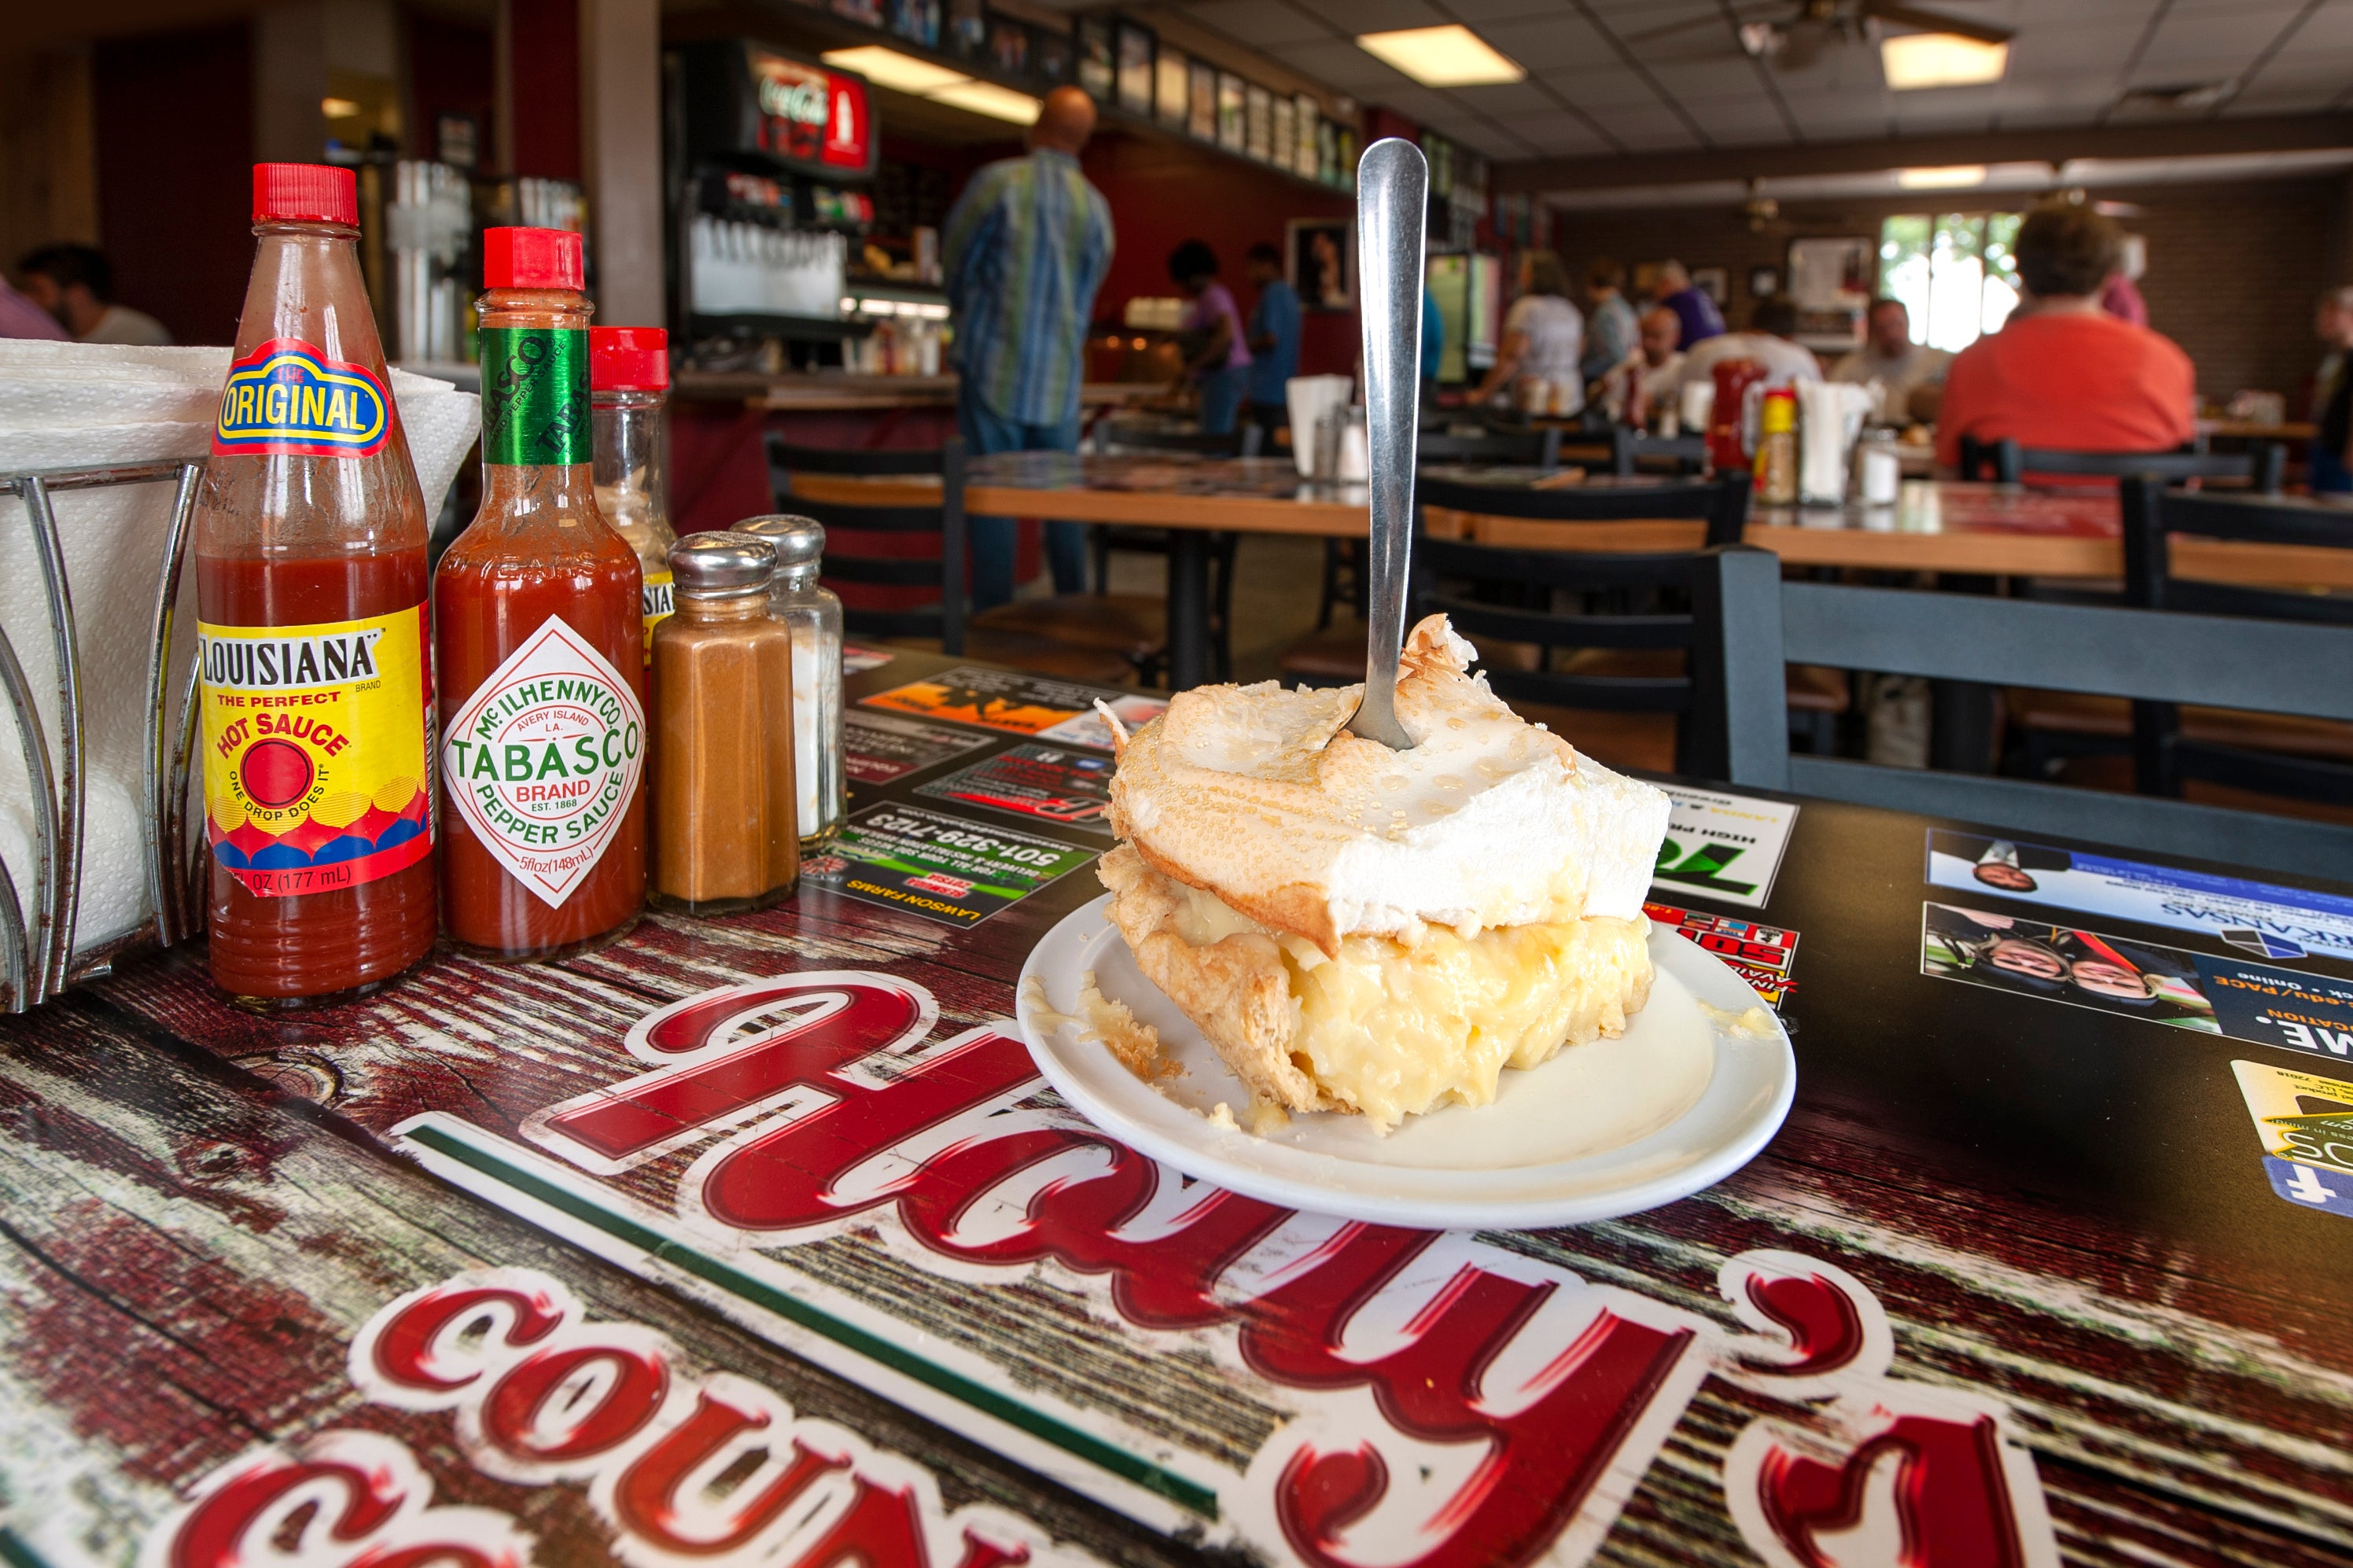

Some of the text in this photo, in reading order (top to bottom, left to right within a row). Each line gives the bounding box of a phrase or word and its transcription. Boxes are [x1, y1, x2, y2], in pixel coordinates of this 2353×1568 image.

[536, 341, 566, 377] SAUCE
[277, 368, 304, 383] THE
[224, 385, 366, 431] ORIGINAL
[355, 680, 381, 693] BRAND
[217, 691, 341, 708] THE PERFECT
[517, 710, 590, 732] AVERY ISLAND
[545, 723, 564, 735] LA.
[216, 713, 350, 760] HOT SAUCE
[451, 720, 639, 782] TABASCO
[230, 771, 245, 801] ONE
[244, 801, 283, 821] DROP
[289, 786, 325, 818] DOES
[517, 779, 591, 802] BRAND
[477, 771, 624, 844] PEPPER SAUCE
[532, 798, 578, 812] EST. 1868
[866, 813, 1062, 868] 501-329-7123
[1702, 829, 1756, 845] HIGH
[278, 871, 314, 893] (177
[321, 865, 352, 884] mL)
[846, 879, 981, 921] LAWSON FARMS
[2237, 972, 2303, 991] Online
[2292, 1084, 2339, 1099] product
